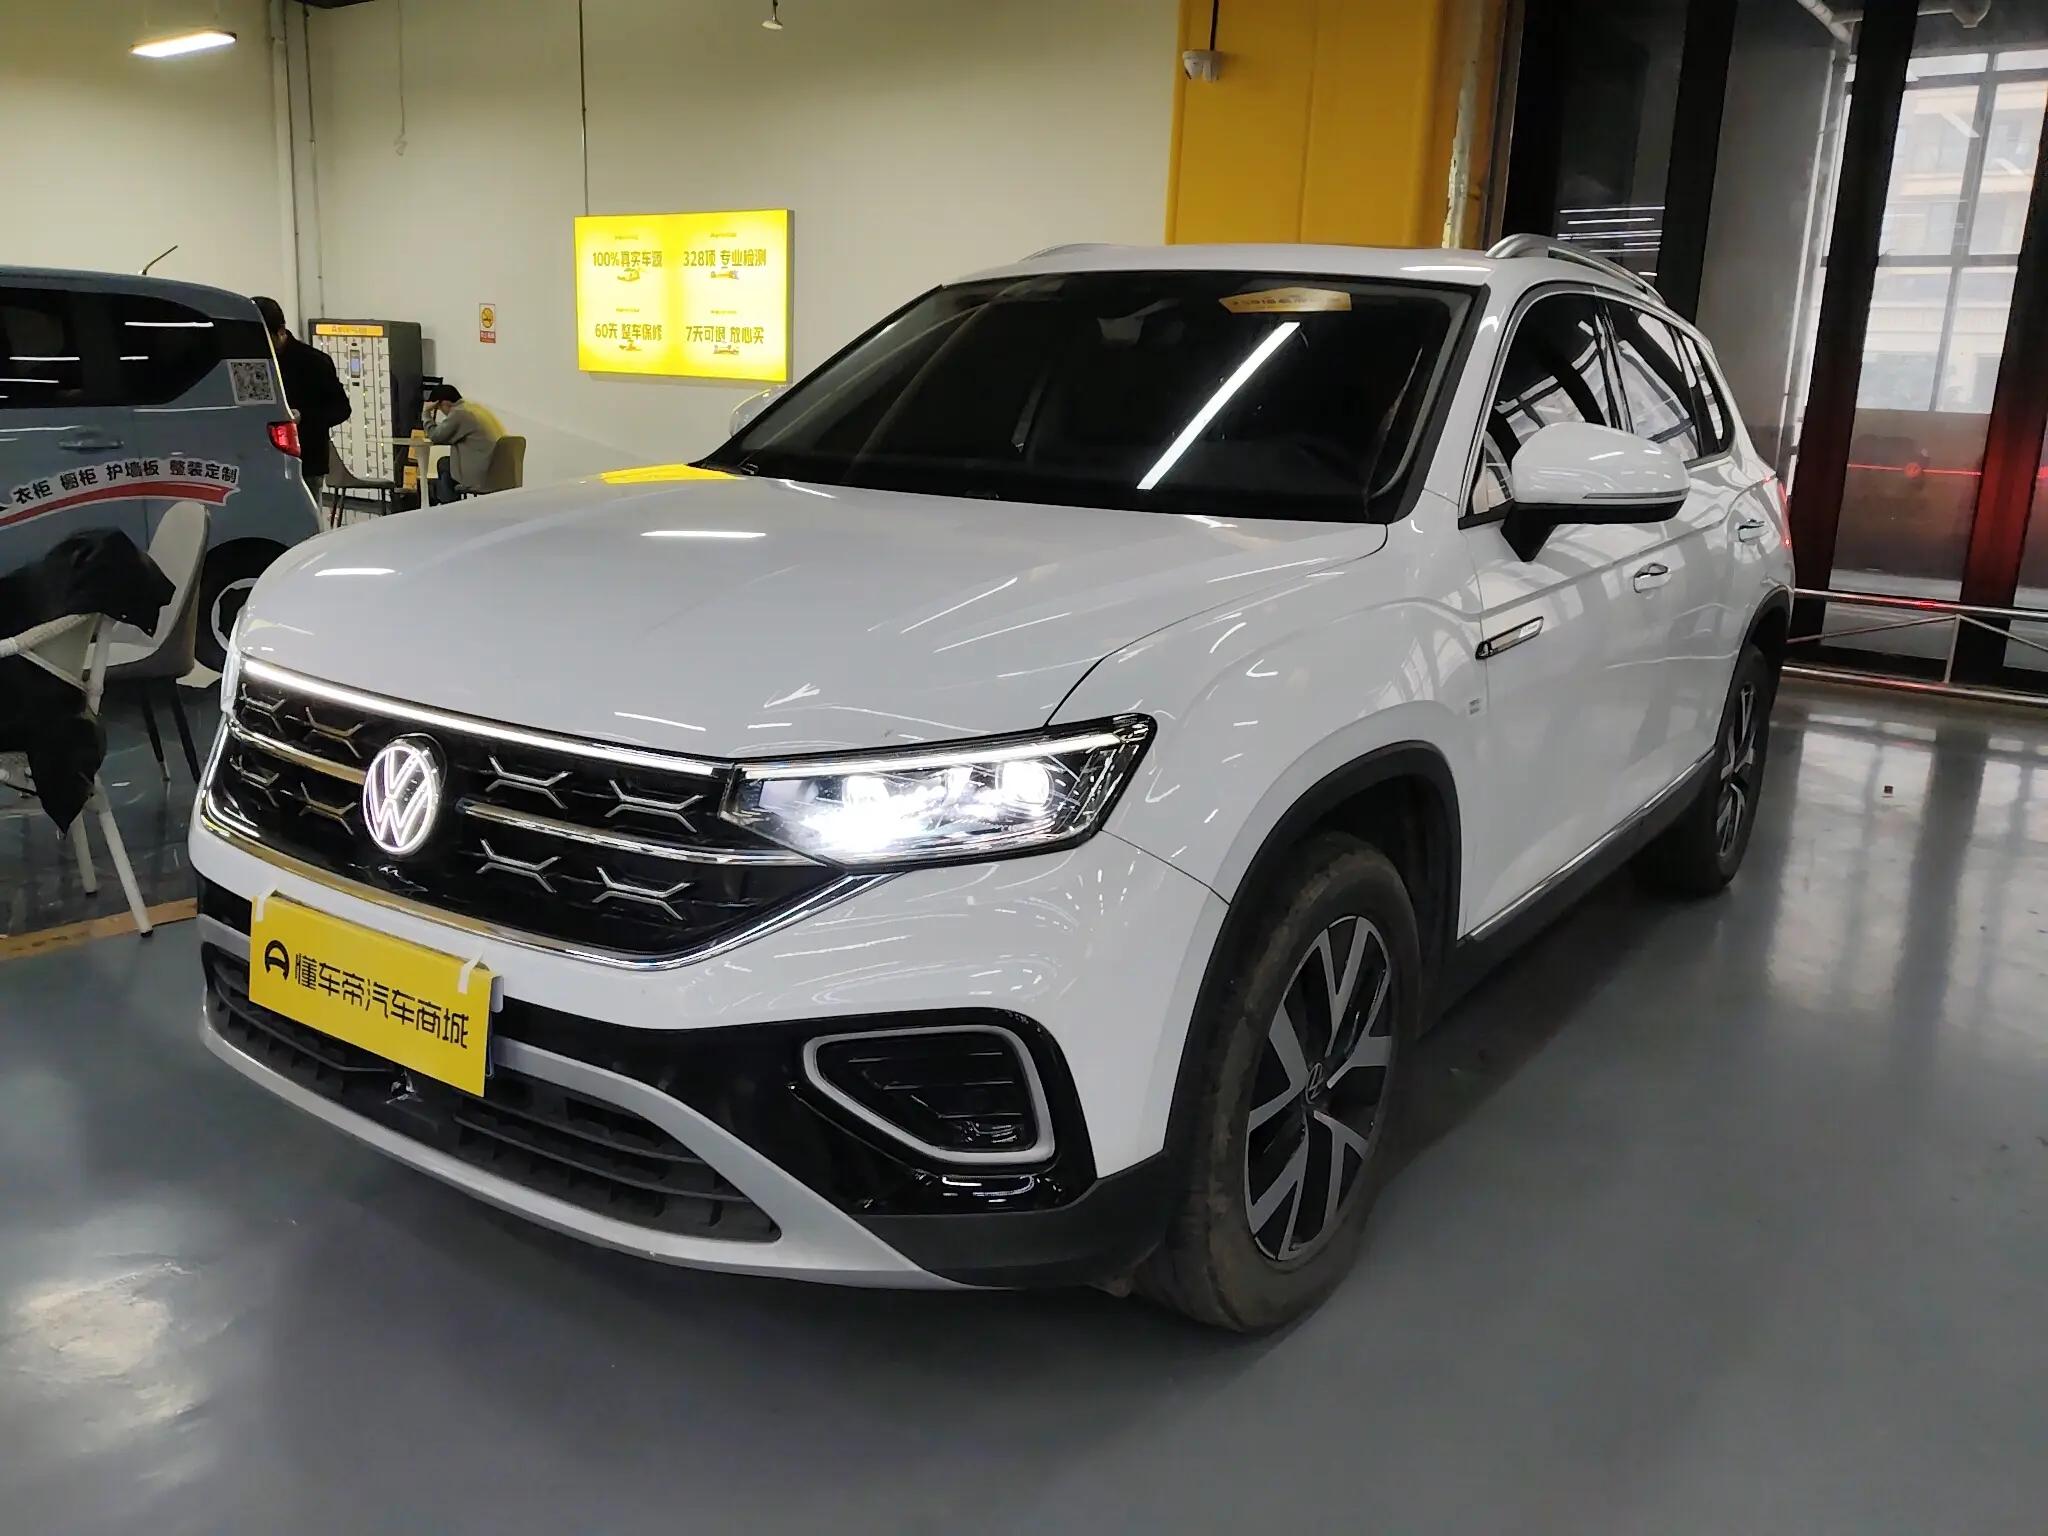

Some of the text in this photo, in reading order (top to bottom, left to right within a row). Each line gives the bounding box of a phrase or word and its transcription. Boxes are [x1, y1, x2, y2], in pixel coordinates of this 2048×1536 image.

[683, 248, 767, 268] 328项 专业检测
[595, 323, 618, 339] 60天
[686, 326, 764, 344] 7天可退 放心买
[13, 480, 53, 504] 衣柜
[106, 461, 159, 481] 护墙板
[169, 459, 238, 484] 整装定制
[295, 953, 469, 1049] 懂车帝汽车商城
